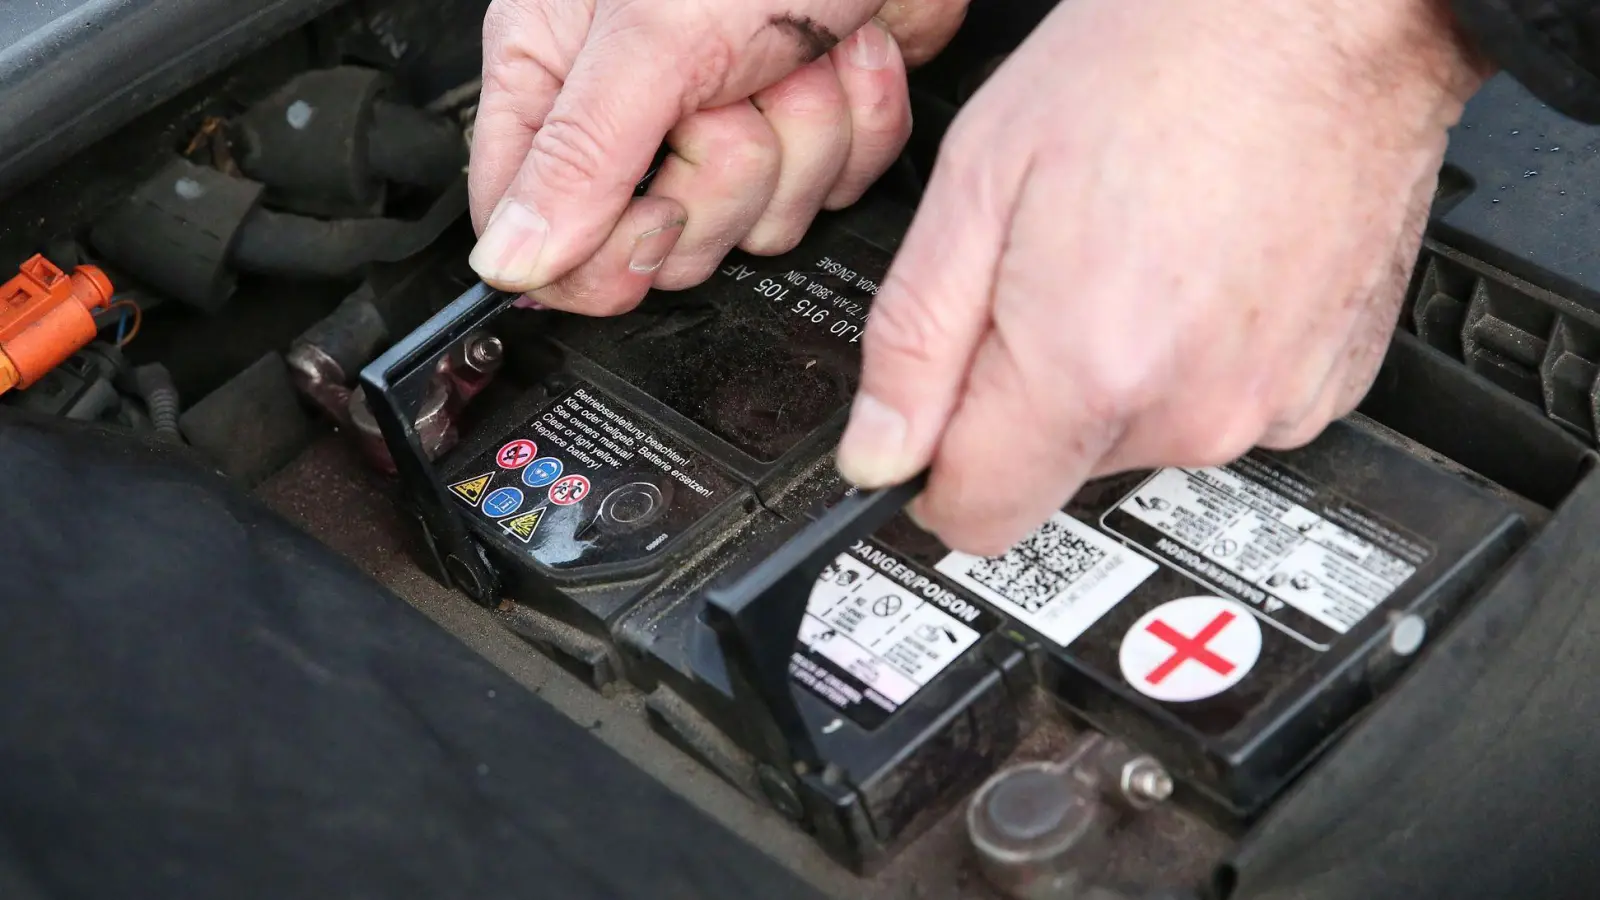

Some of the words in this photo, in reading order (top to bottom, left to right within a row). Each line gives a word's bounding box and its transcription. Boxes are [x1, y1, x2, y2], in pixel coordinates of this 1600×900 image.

[722, 264, 756, 281] AF
[784, 270, 808, 286] DIN
[753, 278, 790, 301] 105
[806, 281, 833, 299] 380A
[791, 299, 830, 323] 915
[553, 405, 571, 419] See
[570, 417, 600, 439] owners
[574, 388, 646, 439] Betriebsanleitung
[645, 435, 690, 466] beachten!
[531, 420, 567, 447] Replace
[566, 444, 602, 470] battery!
[542, 413, 566, 431] Clear
[564, 428, 577, 437] or
[574, 434, 595, 449] light
[590, 447, 622, 469] yellow:
[563, 396, 583, 411] Klar
[581, 409, 602, 424] oder
[600, 421, 634, 446] hellgelb
[638, 446, 671, 471] Batterie
[671, 469, 714, 497] ersetzen!
